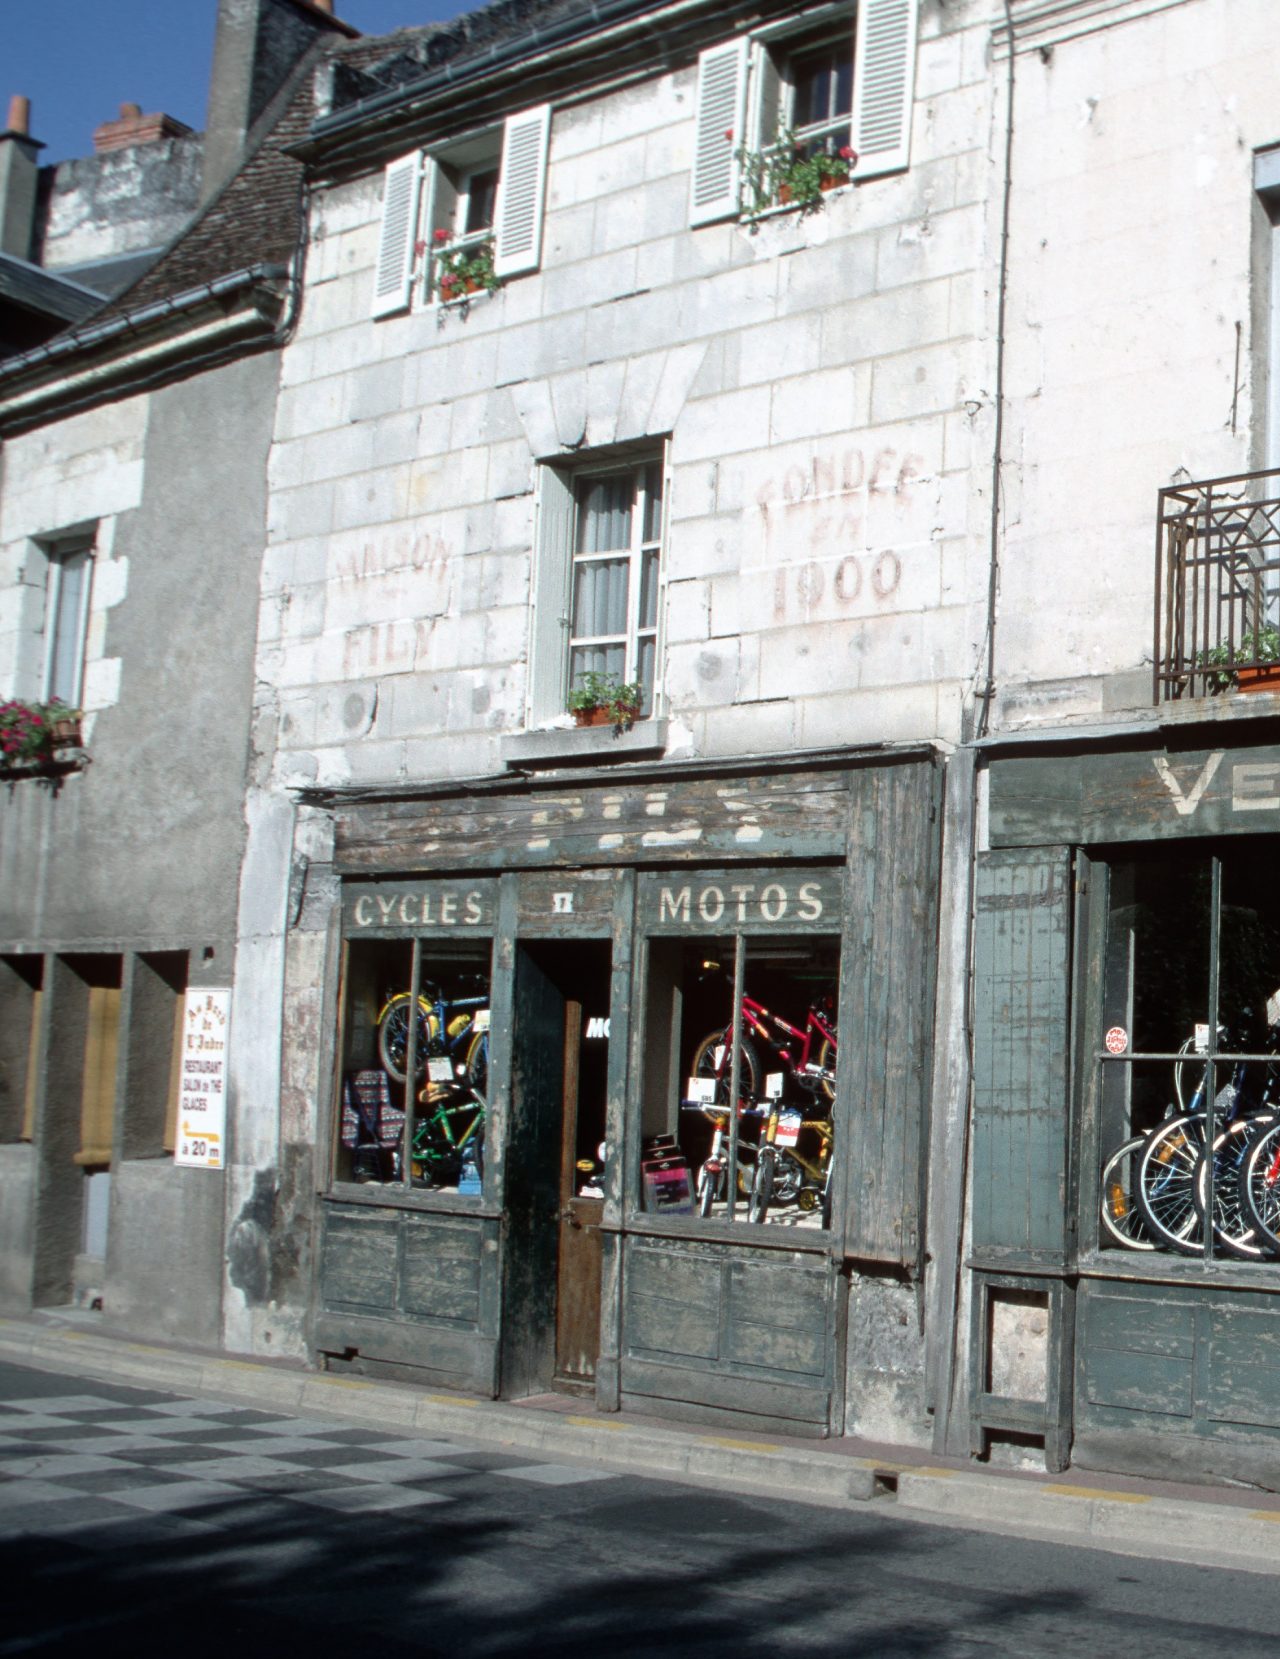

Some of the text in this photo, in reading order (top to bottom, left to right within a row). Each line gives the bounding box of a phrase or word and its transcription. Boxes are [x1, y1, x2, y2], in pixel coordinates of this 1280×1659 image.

[773, 549, 902, 621] 1900
[354, 890, 484, 928] CYCLES
[660, 882, 825, 923] MOTOS
[185, 1059, 222, 1074] RESTAURANT
[183, 1079, 201, 1092] SALON
[183, 1097, 207, 1111] GLACES
[192, 1140, 206, 1156] 20
[209, 1147, 219, 1158] m
